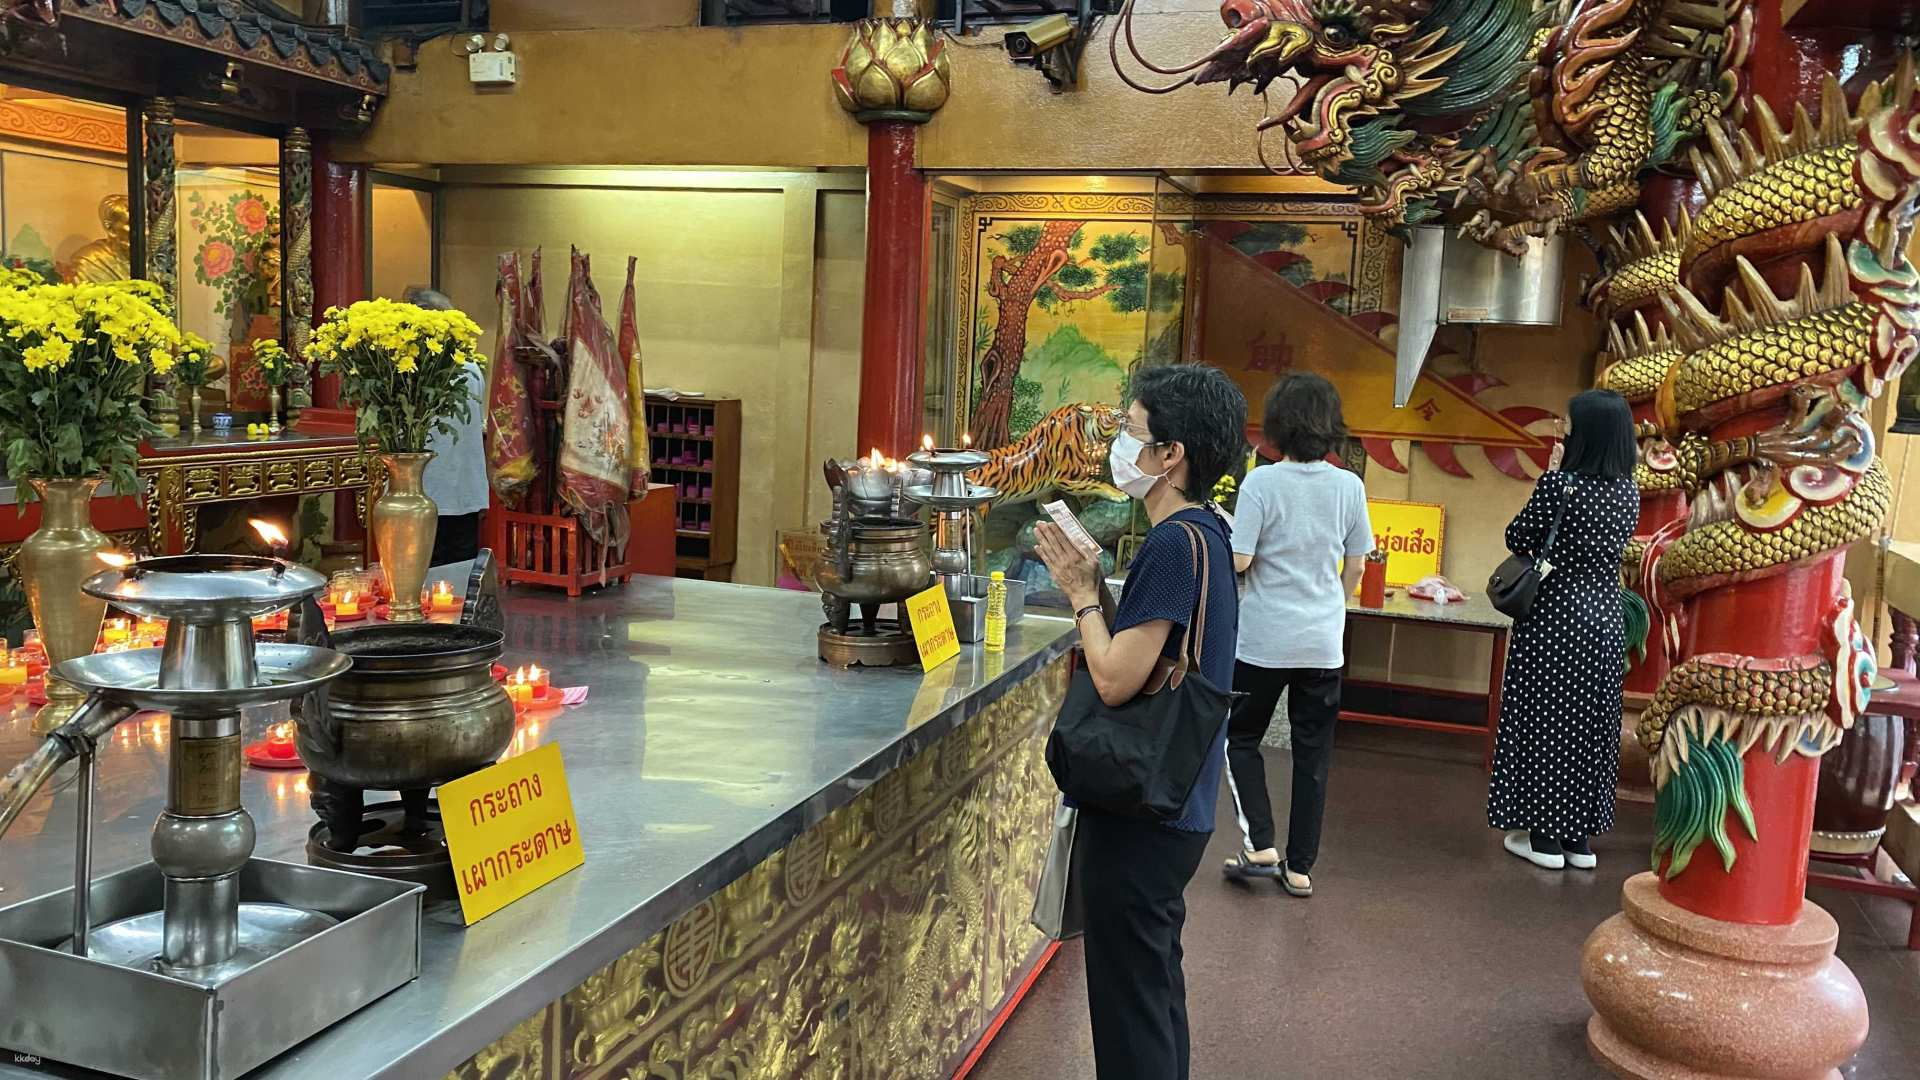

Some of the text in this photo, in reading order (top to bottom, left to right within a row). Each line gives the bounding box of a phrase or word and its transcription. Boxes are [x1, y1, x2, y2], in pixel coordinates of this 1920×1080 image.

[1413, 398, 1442, 422] 令
[469, 773, 543, 827] กระถาง
[461, 819, 573, 895] เผากระดาษ
